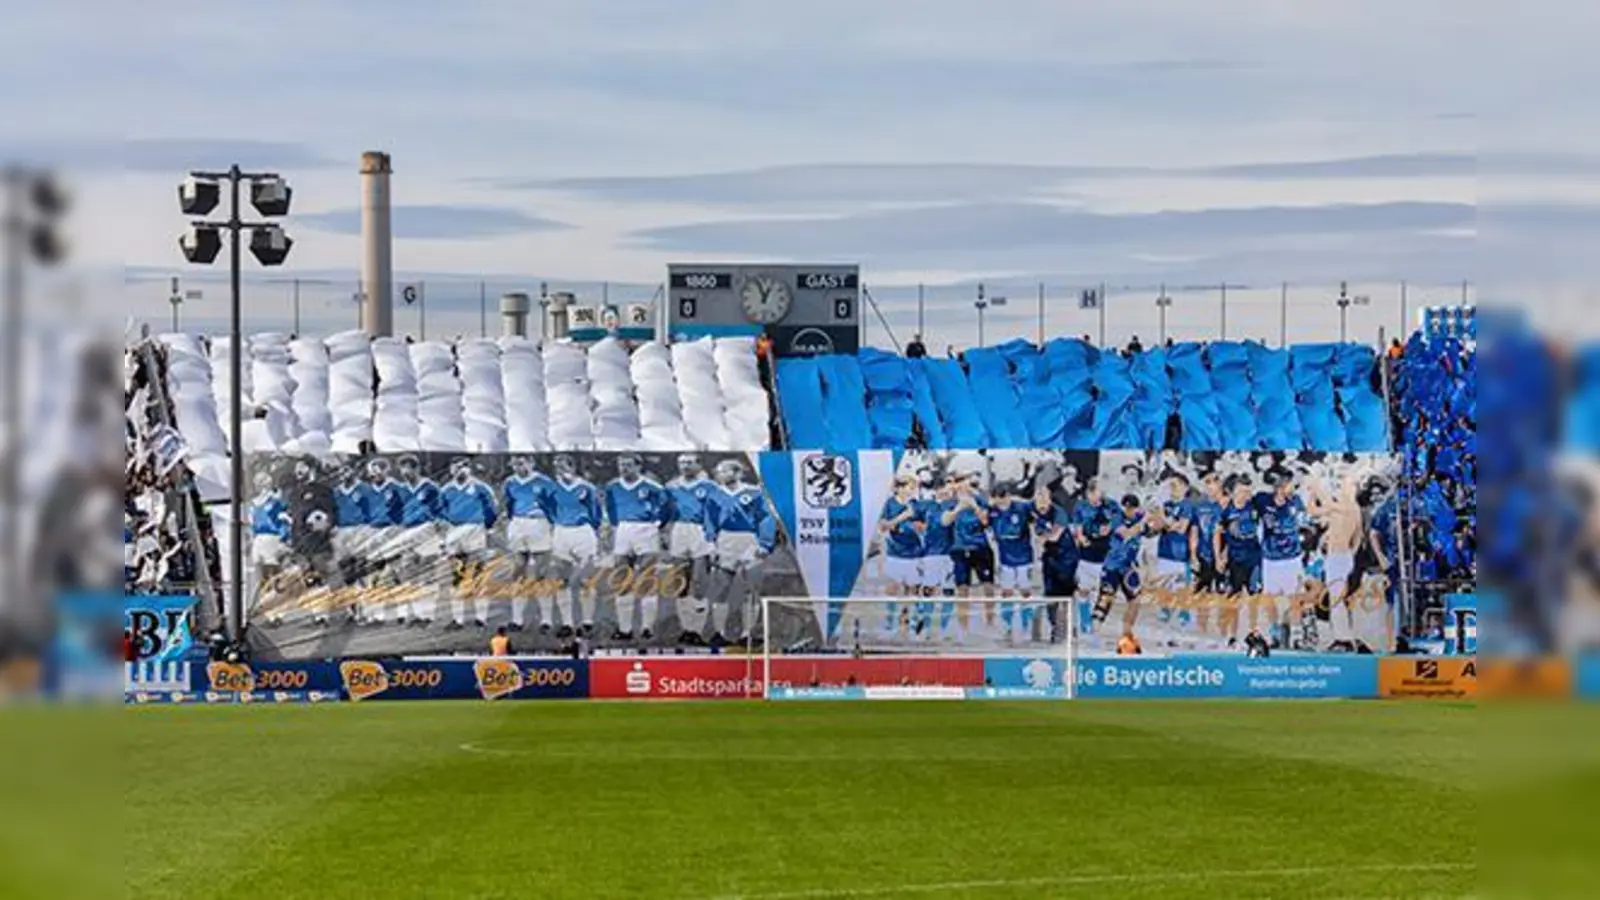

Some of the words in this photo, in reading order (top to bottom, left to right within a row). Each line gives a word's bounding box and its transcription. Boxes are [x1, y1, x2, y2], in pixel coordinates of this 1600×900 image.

[686, 273, 717, 288] 1860
[805, 273, 846, 288] GAST
[403, 286, 416, 304] G
[1082, 289, 1096, 307] H
[683, 300, 693, 316] 0
[838, 300, 848, 316] 0
[800, 518, 825, 529] TSV
[350, 668, 382, 687] Bet
[388, 669, 441, 687] 3000
[483, 667, 518, 686] Bet
[524, 668, 574, 686] 3000
[1103, 664, 1224, 690] Bayerische
[1460, 661, 1476, 677] A
[215, 670, 251, 688] Bet
[256, 671, 307, 689] 3000
